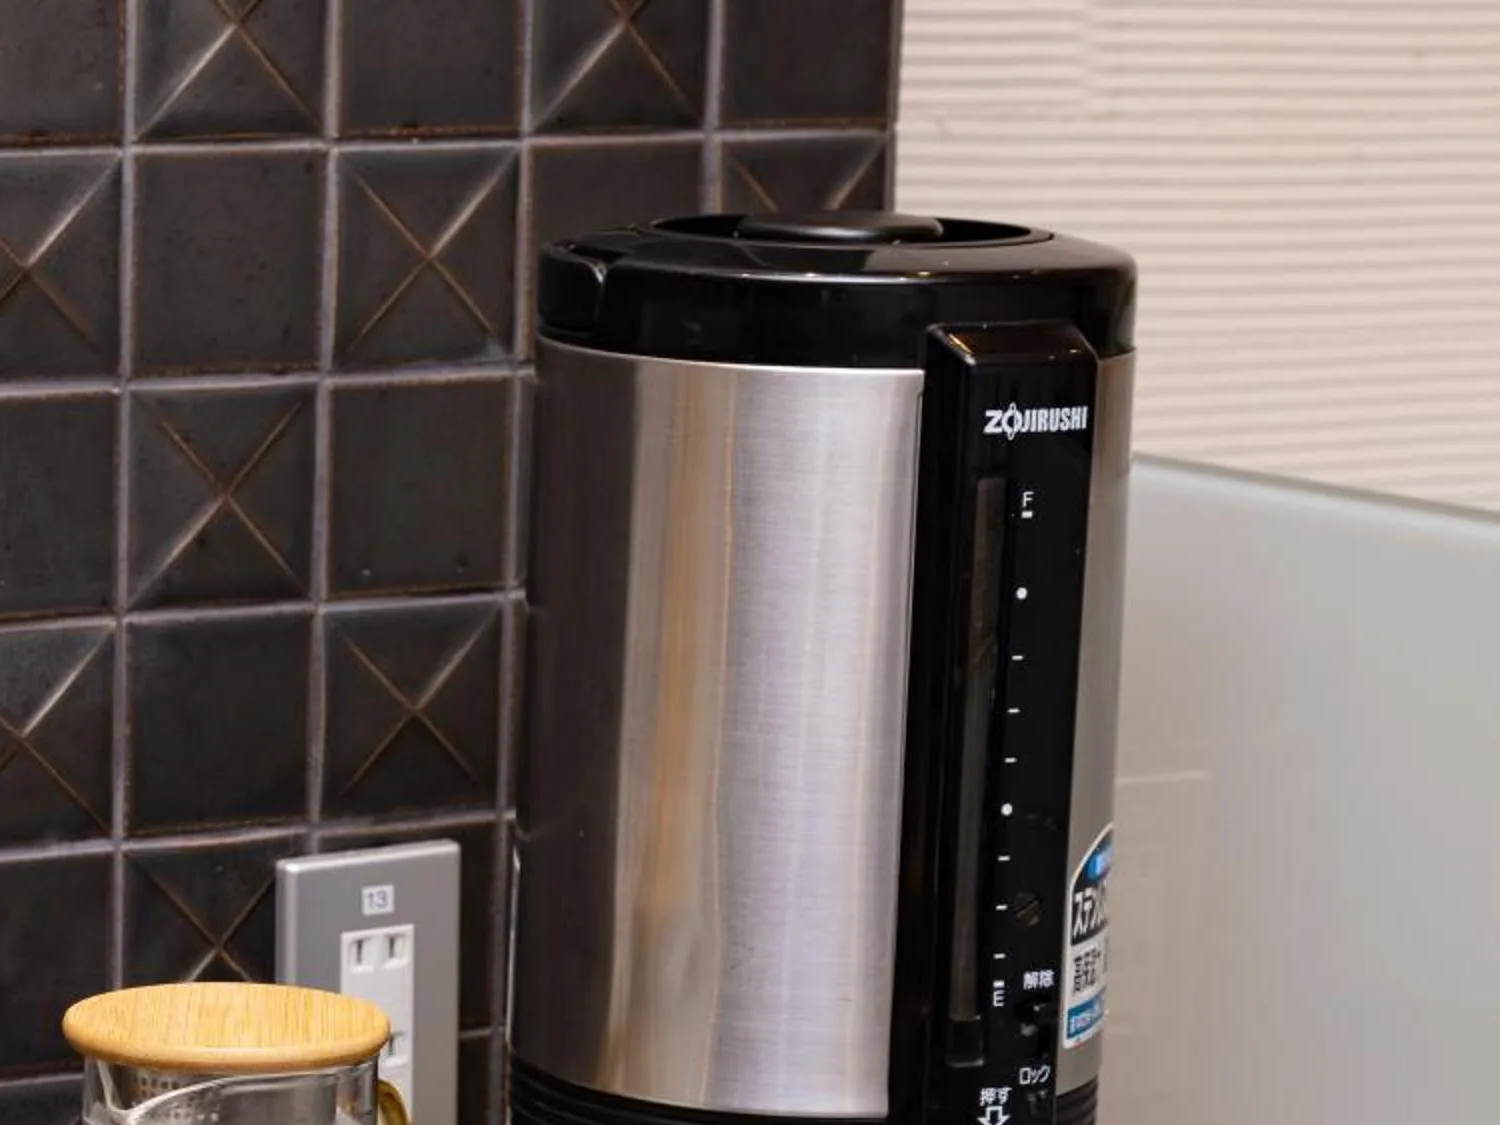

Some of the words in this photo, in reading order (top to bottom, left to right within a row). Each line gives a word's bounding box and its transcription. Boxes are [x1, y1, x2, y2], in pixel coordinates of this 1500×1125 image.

[983, 402, 1088, 440] ZOJIRUSHI
[1022, 491, 1034, 508] F
[367, 888, 389, 910] 13
[1023, 970, 1054, 990] 解除
[993, 990, 1005, 1007] E
[1019, 1065, 1050, 1085] ロック
[980, 1087, 1012, 1106] 押す
